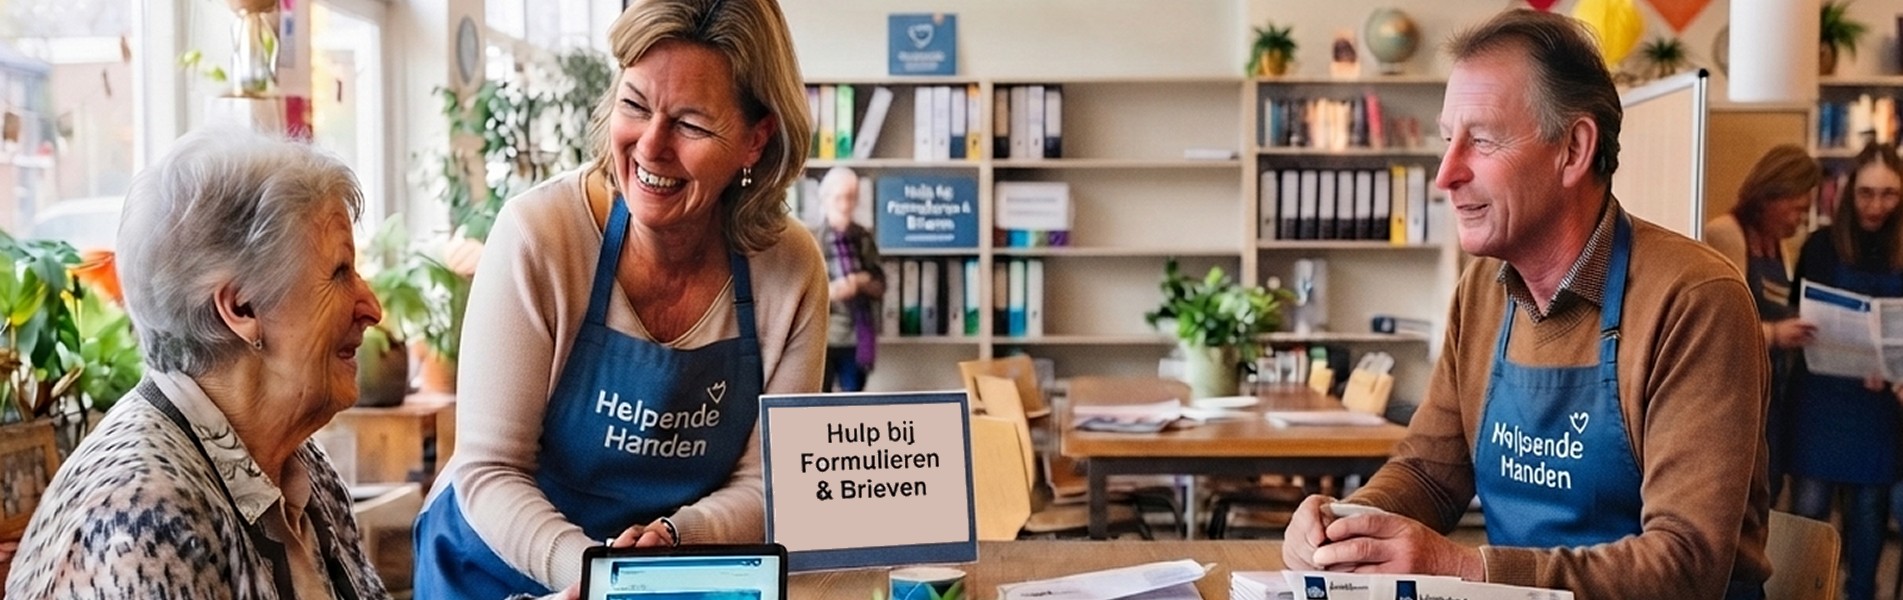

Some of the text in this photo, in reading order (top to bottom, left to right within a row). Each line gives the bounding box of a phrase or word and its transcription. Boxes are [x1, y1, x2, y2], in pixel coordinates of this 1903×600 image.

[595, 389, 720, 431] Helpende
[604, 424, 707, 458] Handen
[827, 420, 916, 447] Hulp bij
[800, 449, 940, 473] Formulieren
[1501, 454, 1572, 489] Handen
[816, 479, 927, 501] & Brieven
